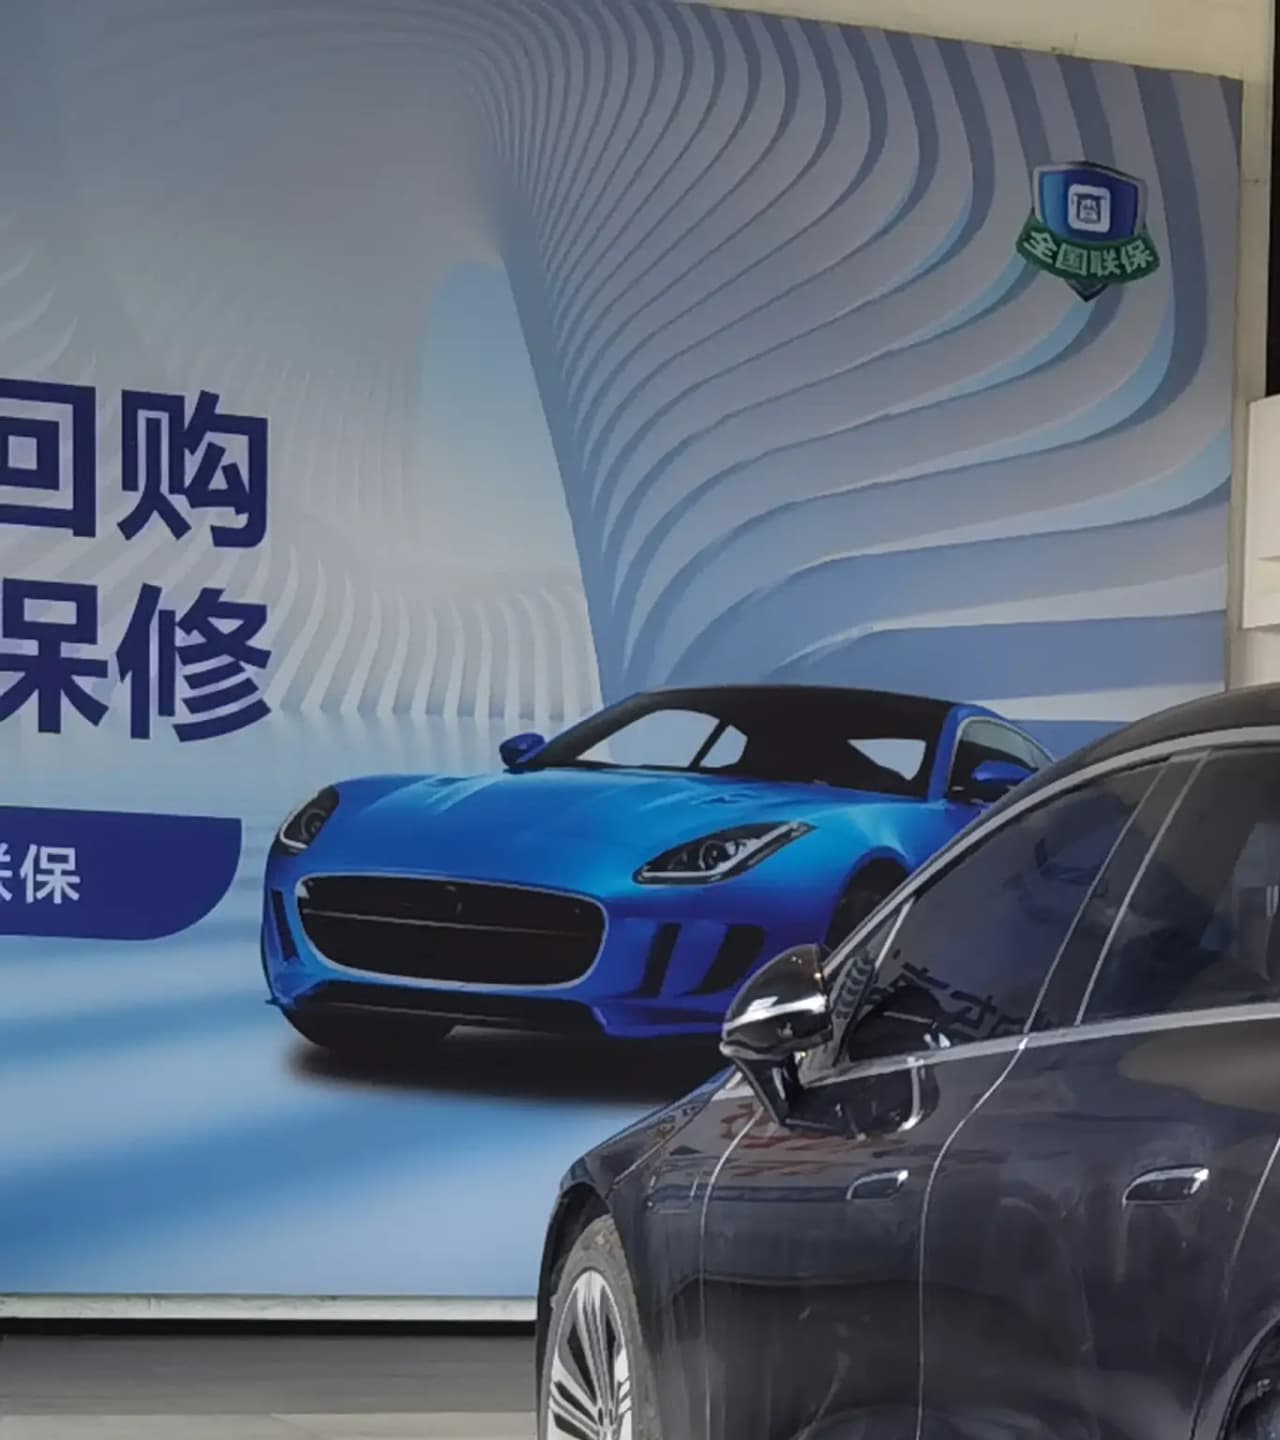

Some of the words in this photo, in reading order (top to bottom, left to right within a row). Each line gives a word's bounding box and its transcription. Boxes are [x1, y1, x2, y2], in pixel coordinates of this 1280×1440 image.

[1022, 231, 1154, 276] 全国联保
[0, 378, 269, 548] 回购
[0, 576, 272, 743] 保修
[0, 842, 82, 905] 保
